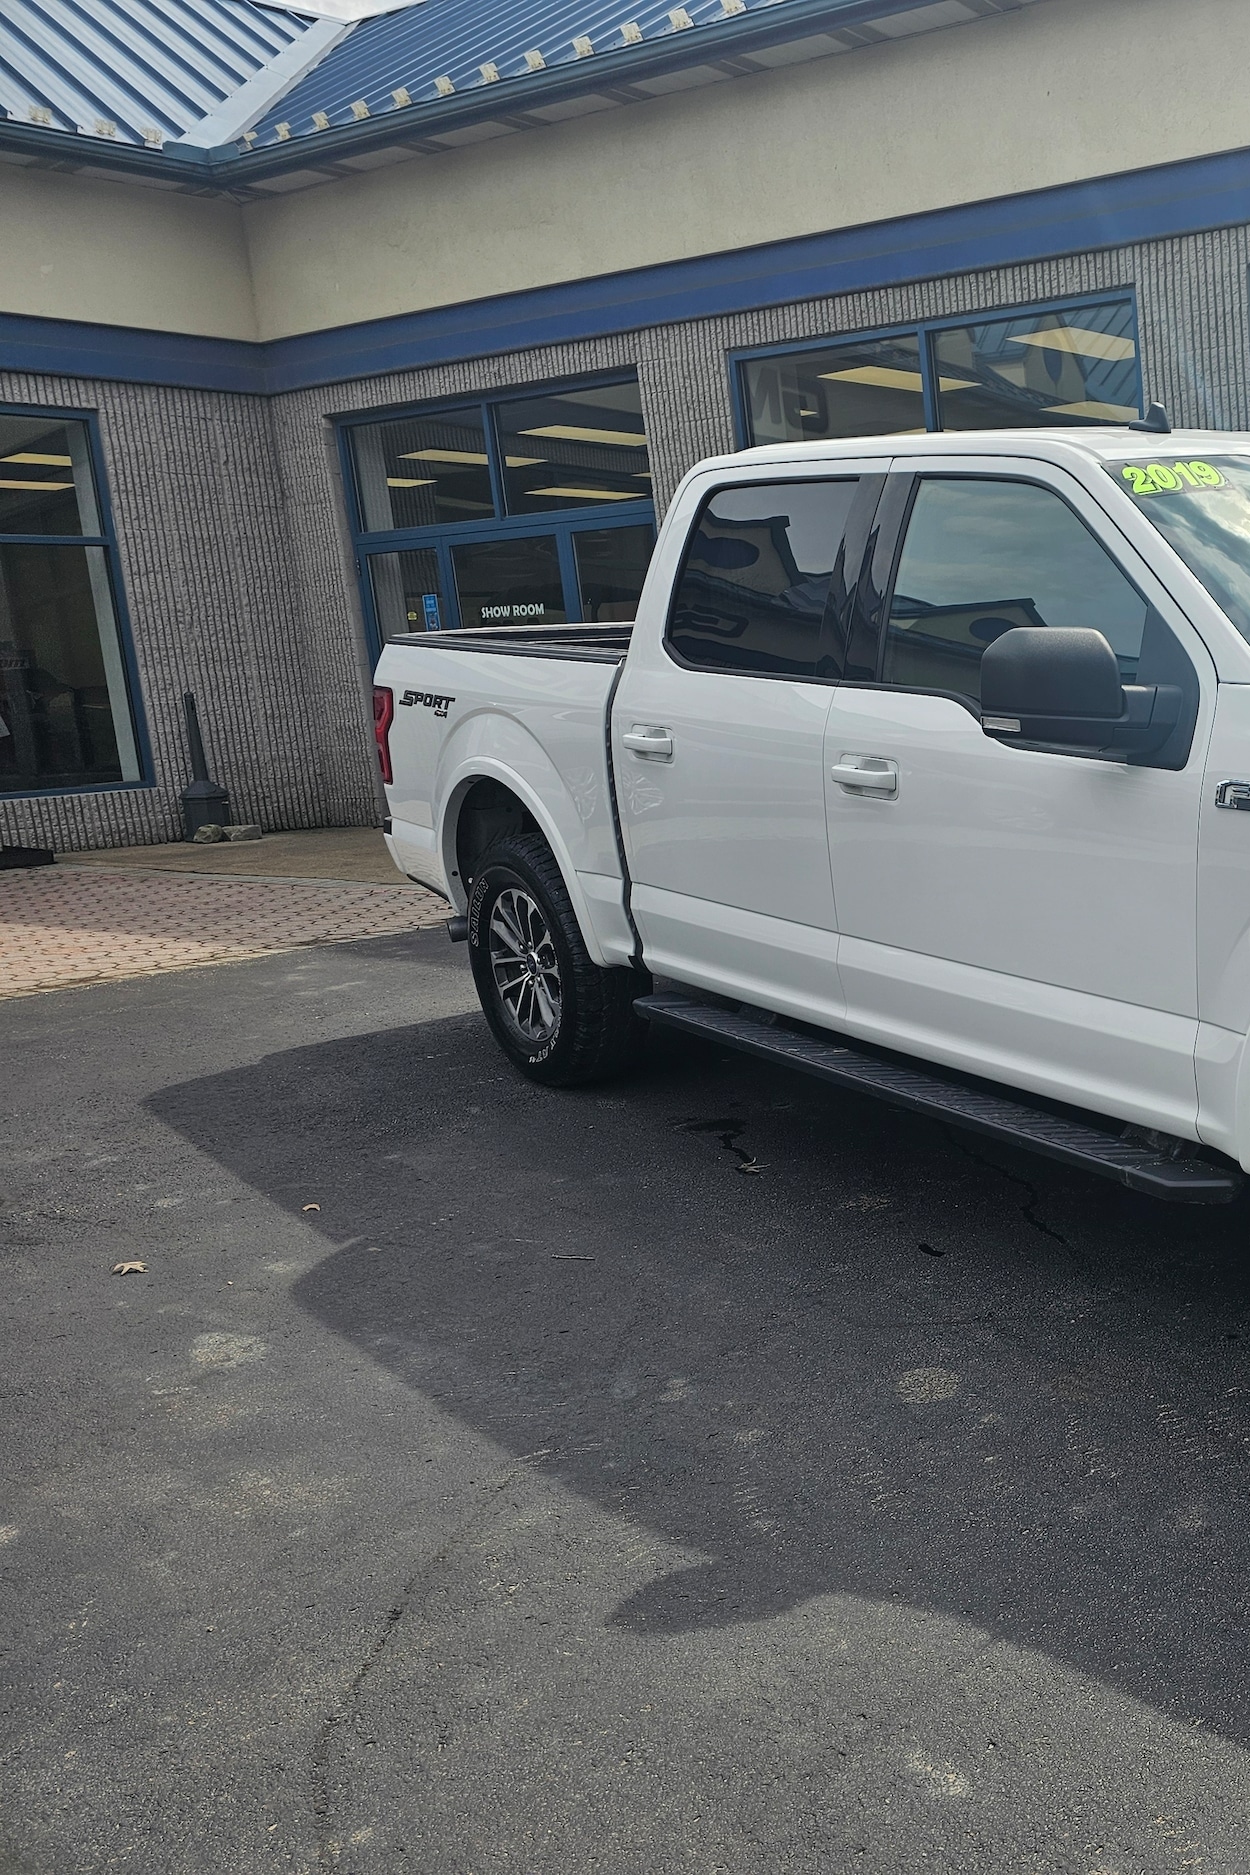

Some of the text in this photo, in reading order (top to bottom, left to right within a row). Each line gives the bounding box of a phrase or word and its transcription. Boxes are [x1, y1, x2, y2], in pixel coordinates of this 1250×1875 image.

[1122, 461, 1225, 495] 2019
[481, 603, 545, 619] SHOW ROOM
[399, 690, 456, 710] SPORT
